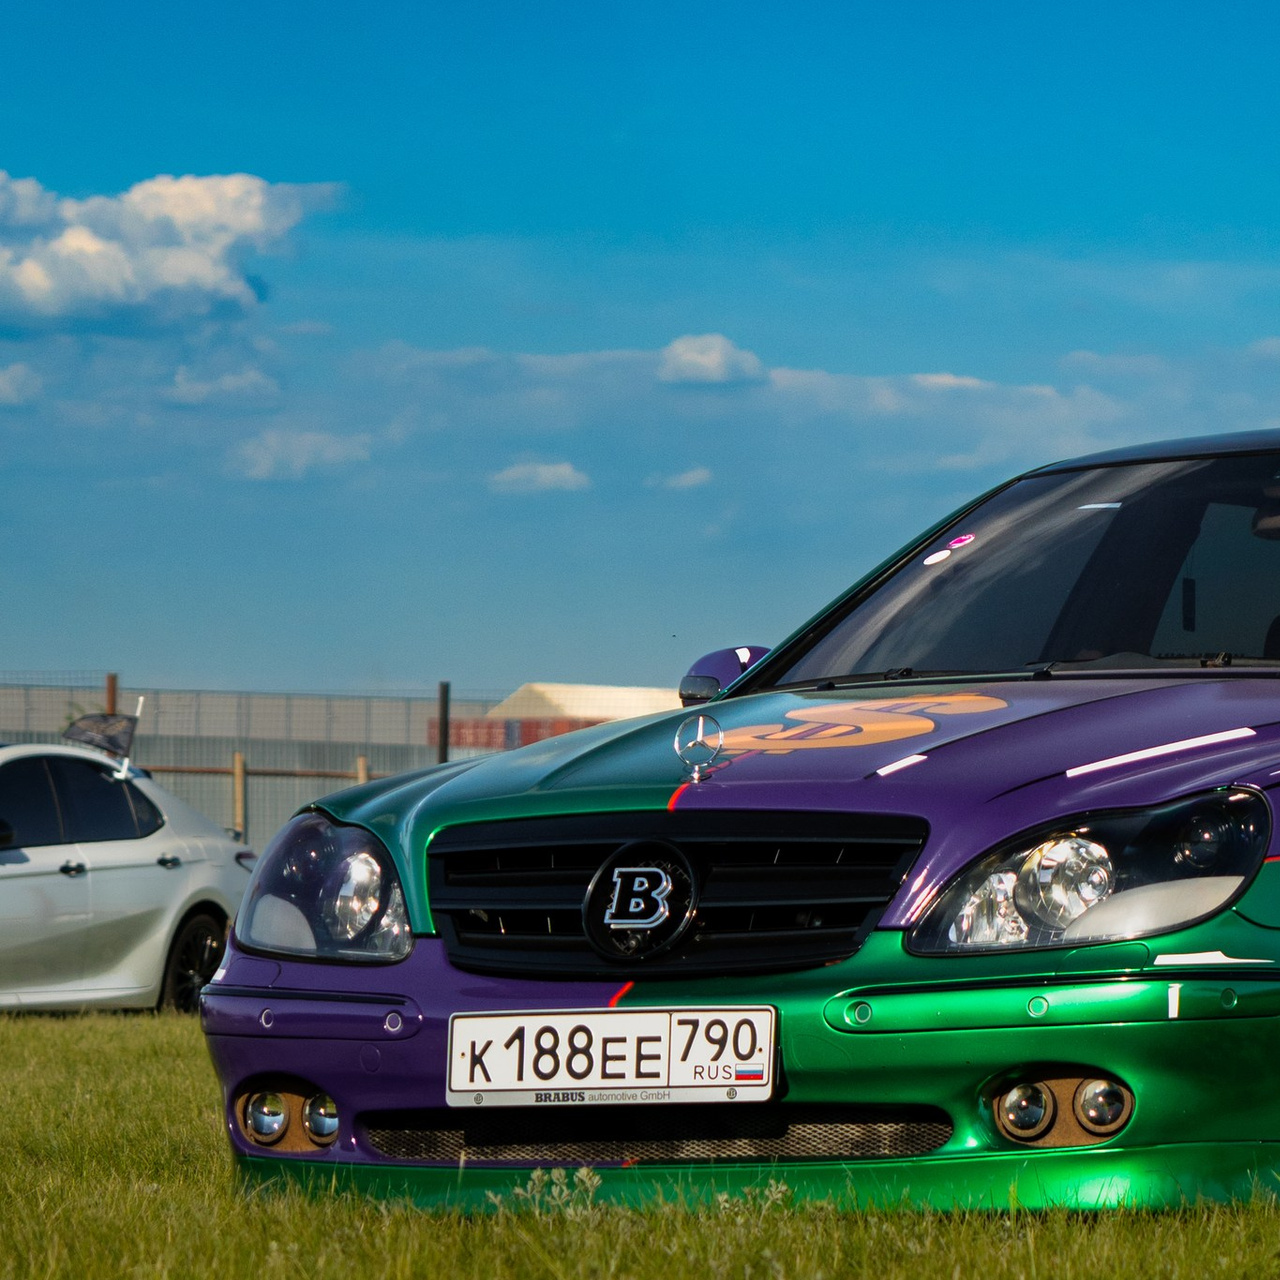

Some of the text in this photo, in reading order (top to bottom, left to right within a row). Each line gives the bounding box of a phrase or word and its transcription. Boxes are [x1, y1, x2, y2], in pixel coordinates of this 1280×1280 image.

[604, 867, 673, 930] B
[469, 1024, 662, 1083] K188EE
[677, 1018, 757, 1062] 790
[693, 1064, 732, 1080] RUS
[534, 1090, 671, 1103] BRABUS automotive GmbH
